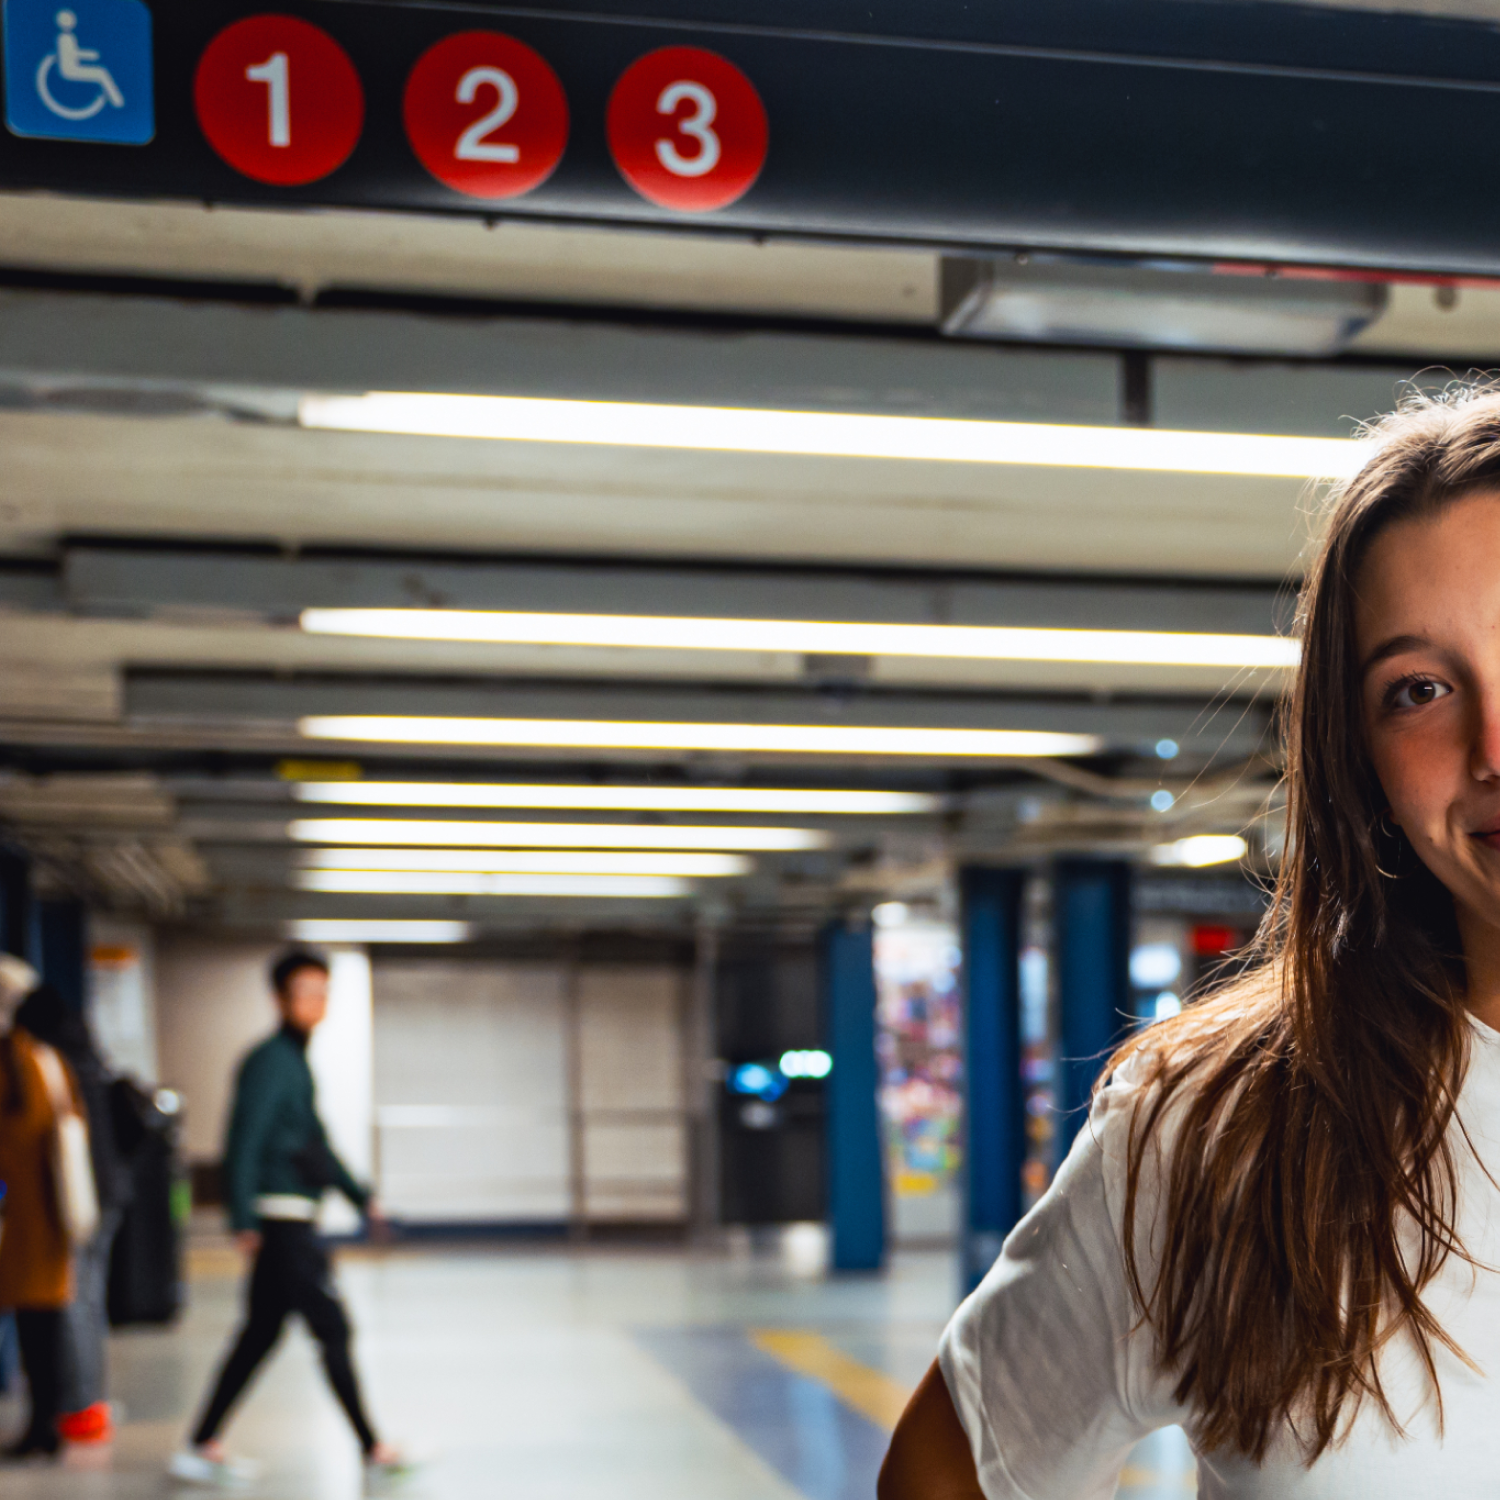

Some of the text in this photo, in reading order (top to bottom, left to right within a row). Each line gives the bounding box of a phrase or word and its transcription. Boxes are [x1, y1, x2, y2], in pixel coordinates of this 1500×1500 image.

[246, 53, 721, 177] 1 2 3
